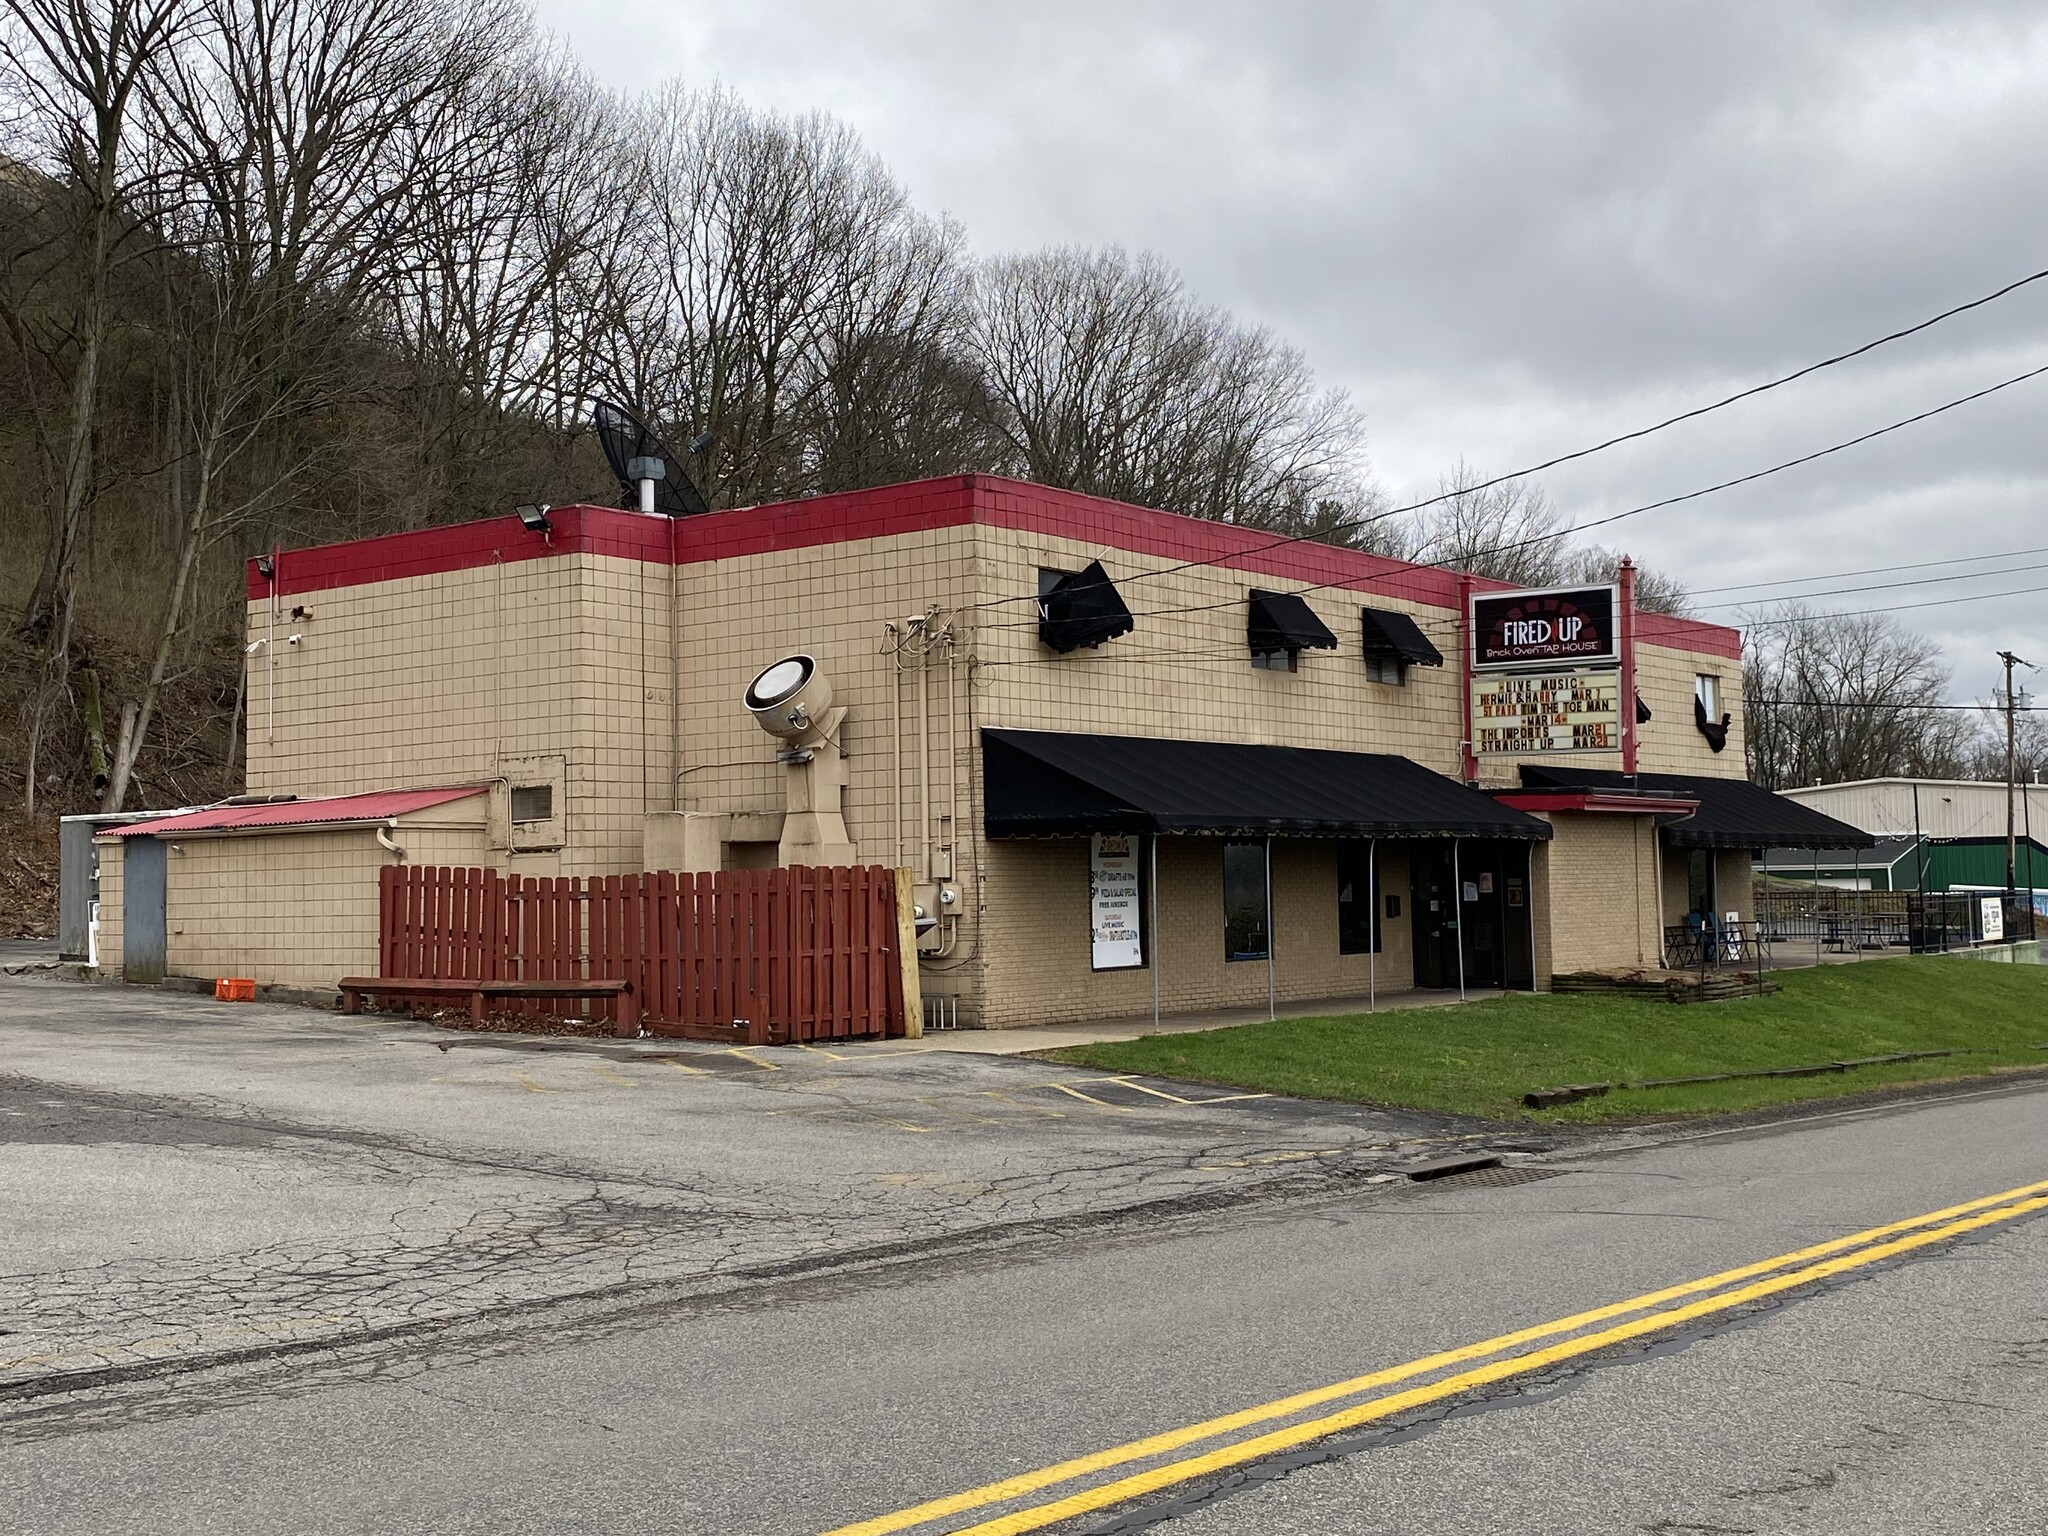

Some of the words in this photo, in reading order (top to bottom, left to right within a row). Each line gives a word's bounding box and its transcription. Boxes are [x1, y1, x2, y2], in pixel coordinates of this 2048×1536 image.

[1504, 620, 1552, 646] FIRED
[1559, 617, 1582, 641] UP
[1513, 647, 1539, 656] Oven
[1536, 645, 1560, 654] TAP
[1562, 641, 1598, 652] HOUSE
[1506, 681, 1531, 692] LIVE
[1541, 678, 1577, 690] MUSIC
[1480, 693, 1512, 706] HERMIE
[1571, 689, 1592, 701] MAR
[1483, 705, 1492, 717] ST
[1495, 704, 1517, 716] PATS
[1521, 703, 1538, 715] TIM
[1541, 702, 1558, 714] THE
[1563, 701, 1582, 713] TOE
[1586, 700, 1609, 712] MAN
[1527, 715, 1548, 727] MAR
[1481, 728, 1498, 740] THE
[1502, 726, 1549, 740] IMPORTS
[1481, 739, 1535, 752] STRAIGHT
[1540, 738, 1554, 750] UP
